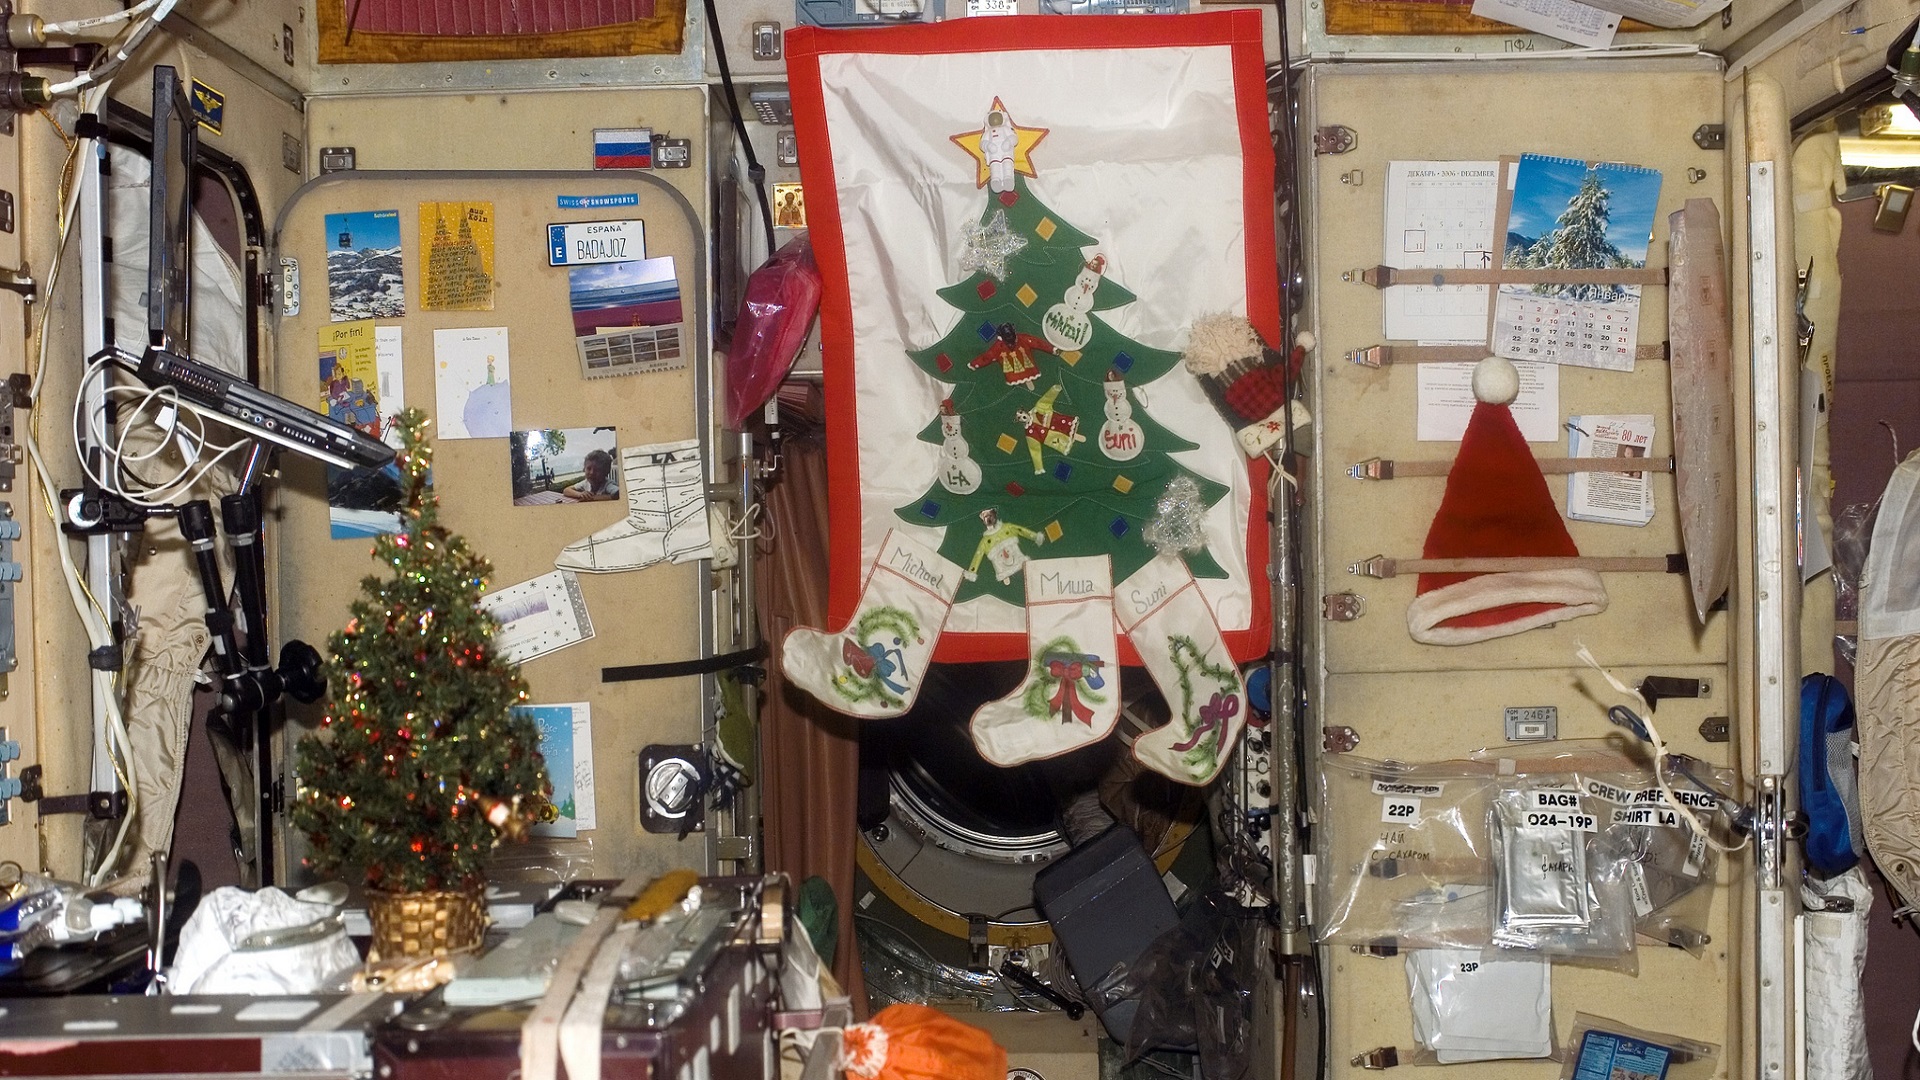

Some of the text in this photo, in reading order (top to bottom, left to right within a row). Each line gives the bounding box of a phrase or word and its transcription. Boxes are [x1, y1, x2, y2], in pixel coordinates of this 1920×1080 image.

[560, 196, 634, 206] SWISS SNOWSPORTS
[556, 247, 563, 258] E
[577, 238, 627, 260] BADAJOZ
[350, 327, 363, 337] fin!
[1104, 428, 1136, 450] Suni
[1622, 429, 1632, 441] 80
[1634, 435, 1648, 444] лет
[890, 546, 944, 590] Michael
[1040, 572, 1094, 596] Миша
[1131, 581, 1167, 615] Suni
[1524, 710, 1543, 720] 246
[1538, 794, 1577, 807] BAG#
[1588, 782, 1715, 808] CREW PREFRENCE
[1389, 805, 1414, 817] 22P
[1614, 811, 1676, 825] SHIRT LA
[1460, 962, 1478, 972] 23P
